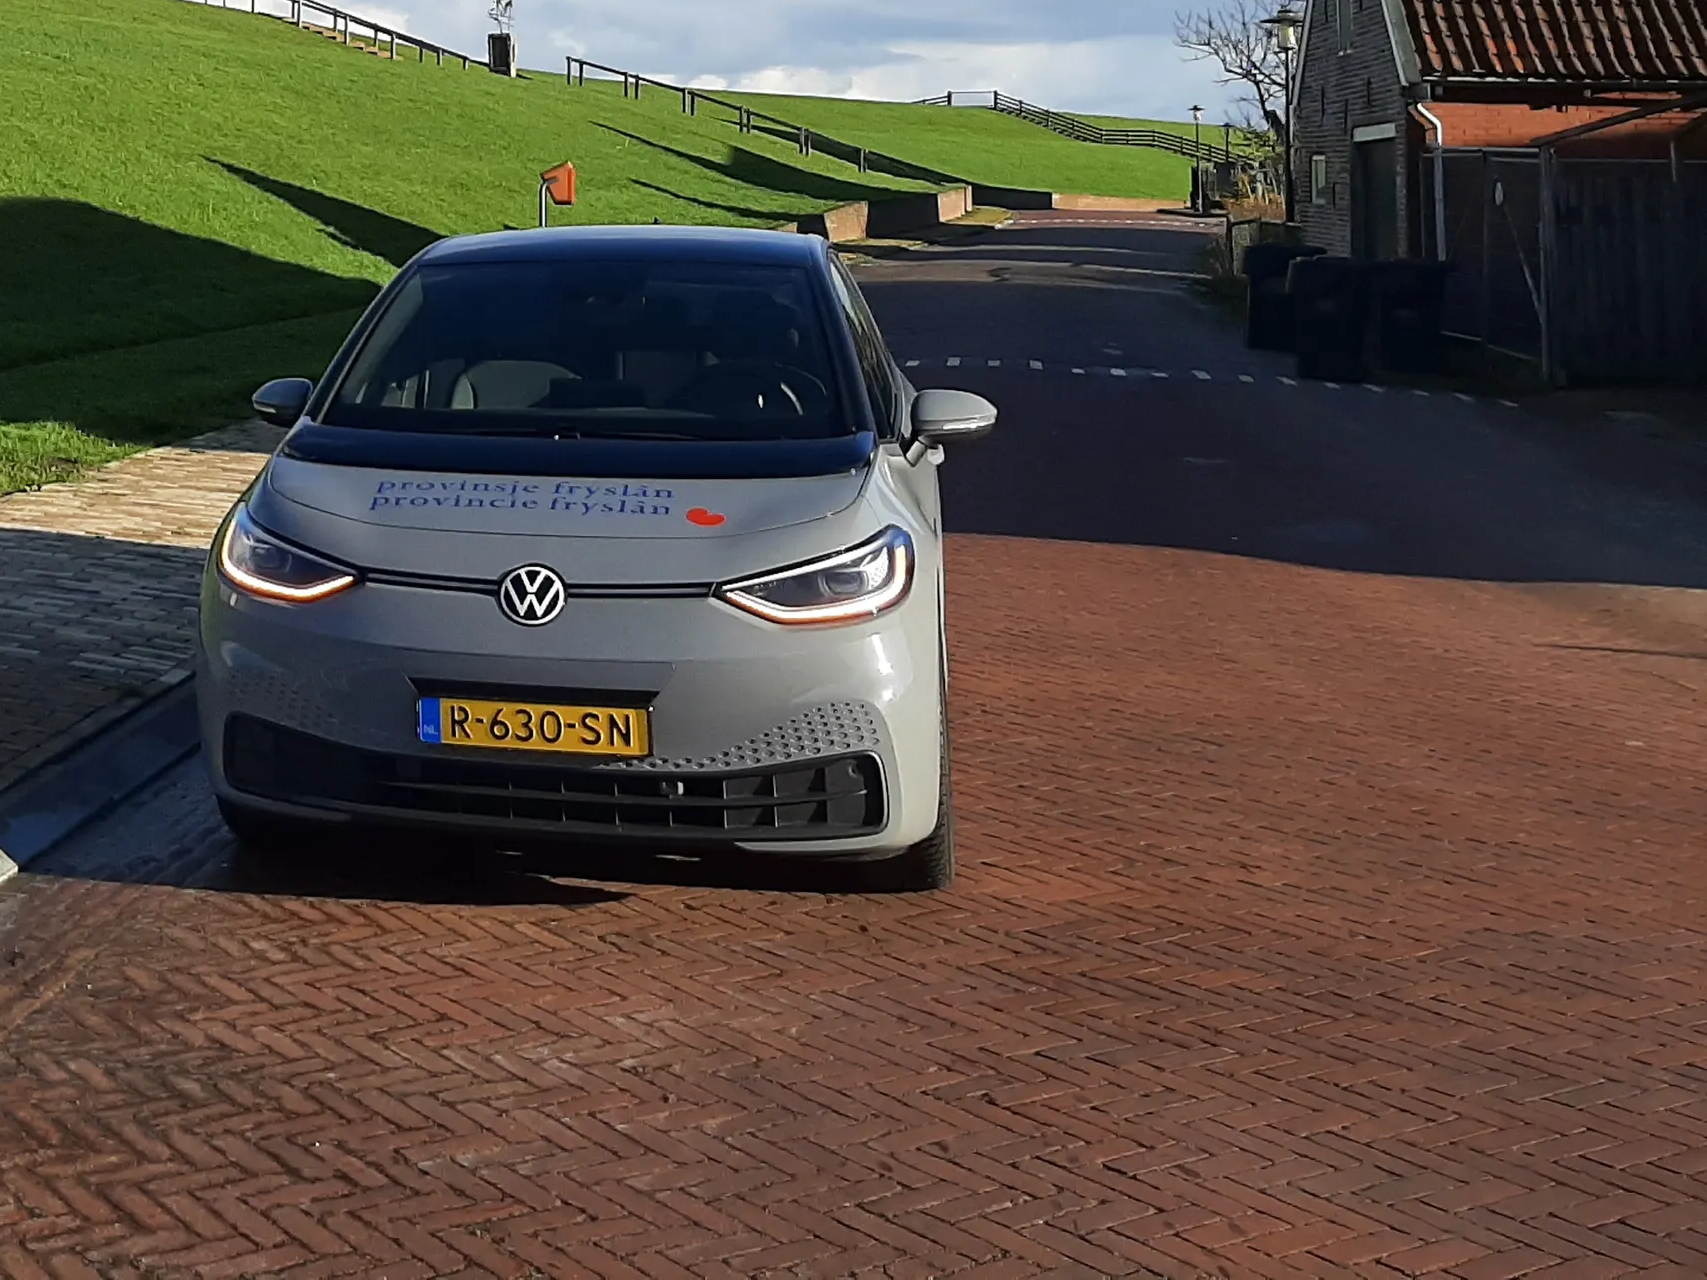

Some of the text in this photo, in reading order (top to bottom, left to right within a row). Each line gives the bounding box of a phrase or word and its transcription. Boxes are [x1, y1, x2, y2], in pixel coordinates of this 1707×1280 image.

[376, 480, 540, 497] provinsje
[369, 493, 671, 517] provincie fryslân
[423, 704, 635, 748] NL R-630-SN
